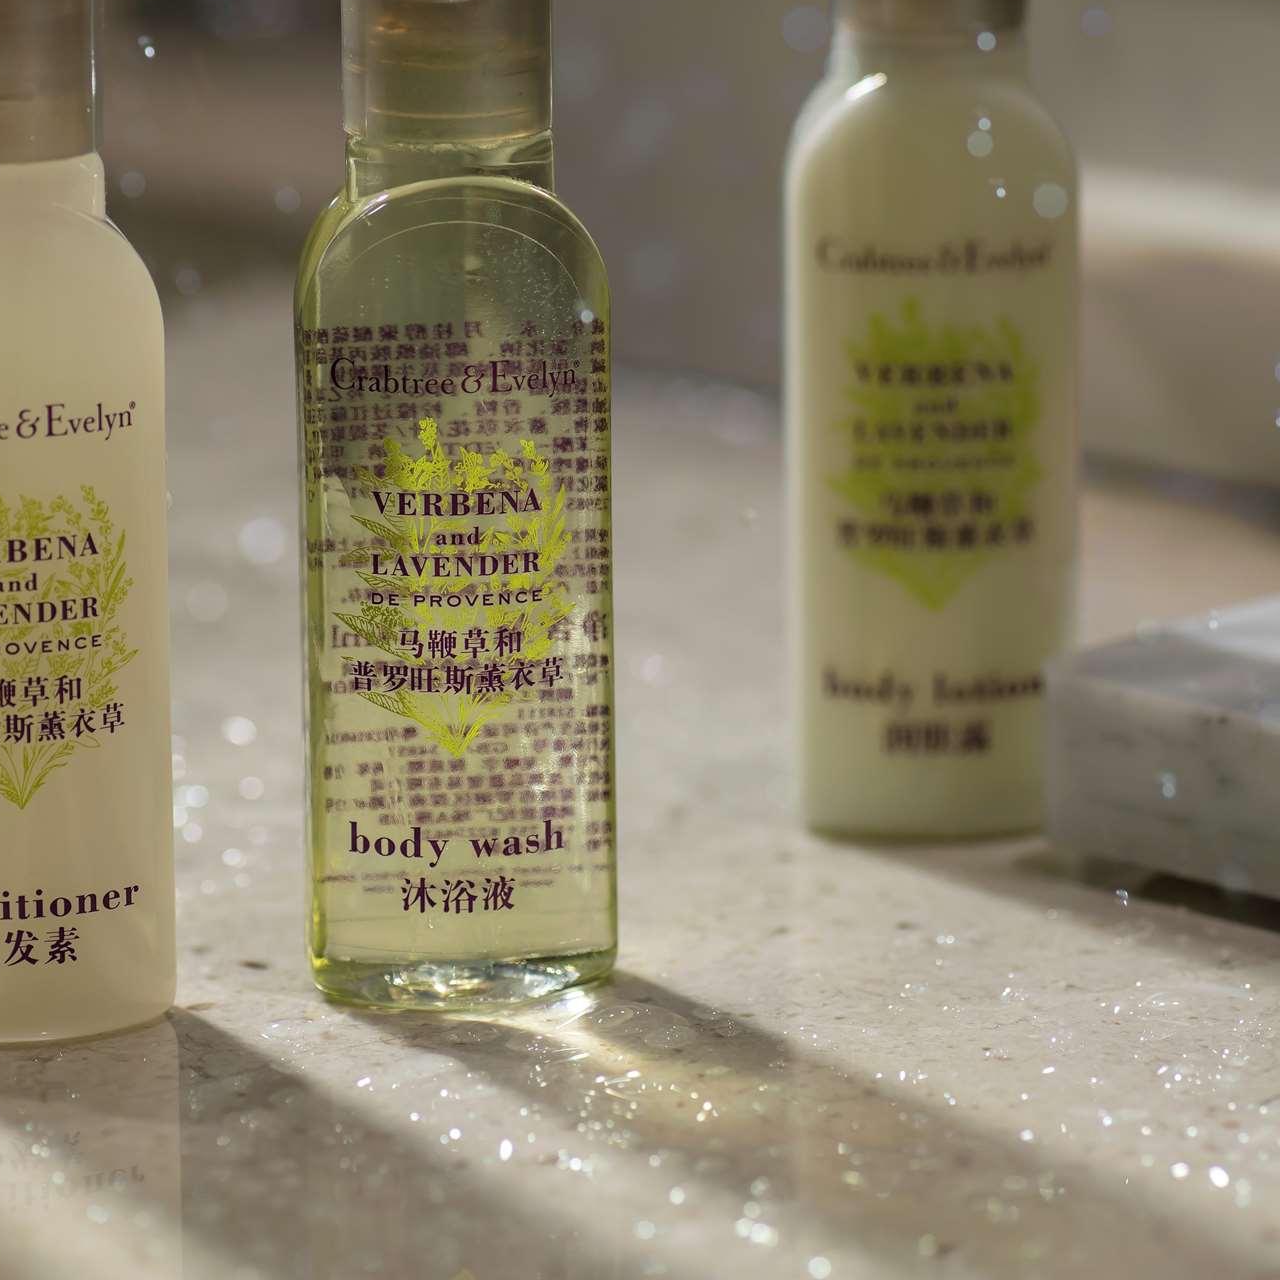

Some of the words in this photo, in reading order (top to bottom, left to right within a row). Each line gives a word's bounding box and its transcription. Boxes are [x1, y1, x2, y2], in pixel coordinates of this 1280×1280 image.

[330, 357, 454, 396] Crabtree
[461, 366, 483, 394] &
[16, 409, 40, 439] &
[372, 487, 542, 517] VERBENA
[436, 526, 481, 546] and
[371, 552, 540, 578] LAVENDER
[371, 592, 400, 607] DE
[413, 589, 543, 608] PROVENCE
[395, 626, 523, 660] 马鞭草和
[348, 657, 564, 695] 普罗旺斯薰衣草
[349, 820, 450, 867] body
[469, 820, 565, 859] wash
[401, 875, 516, 914] 沐浴液
